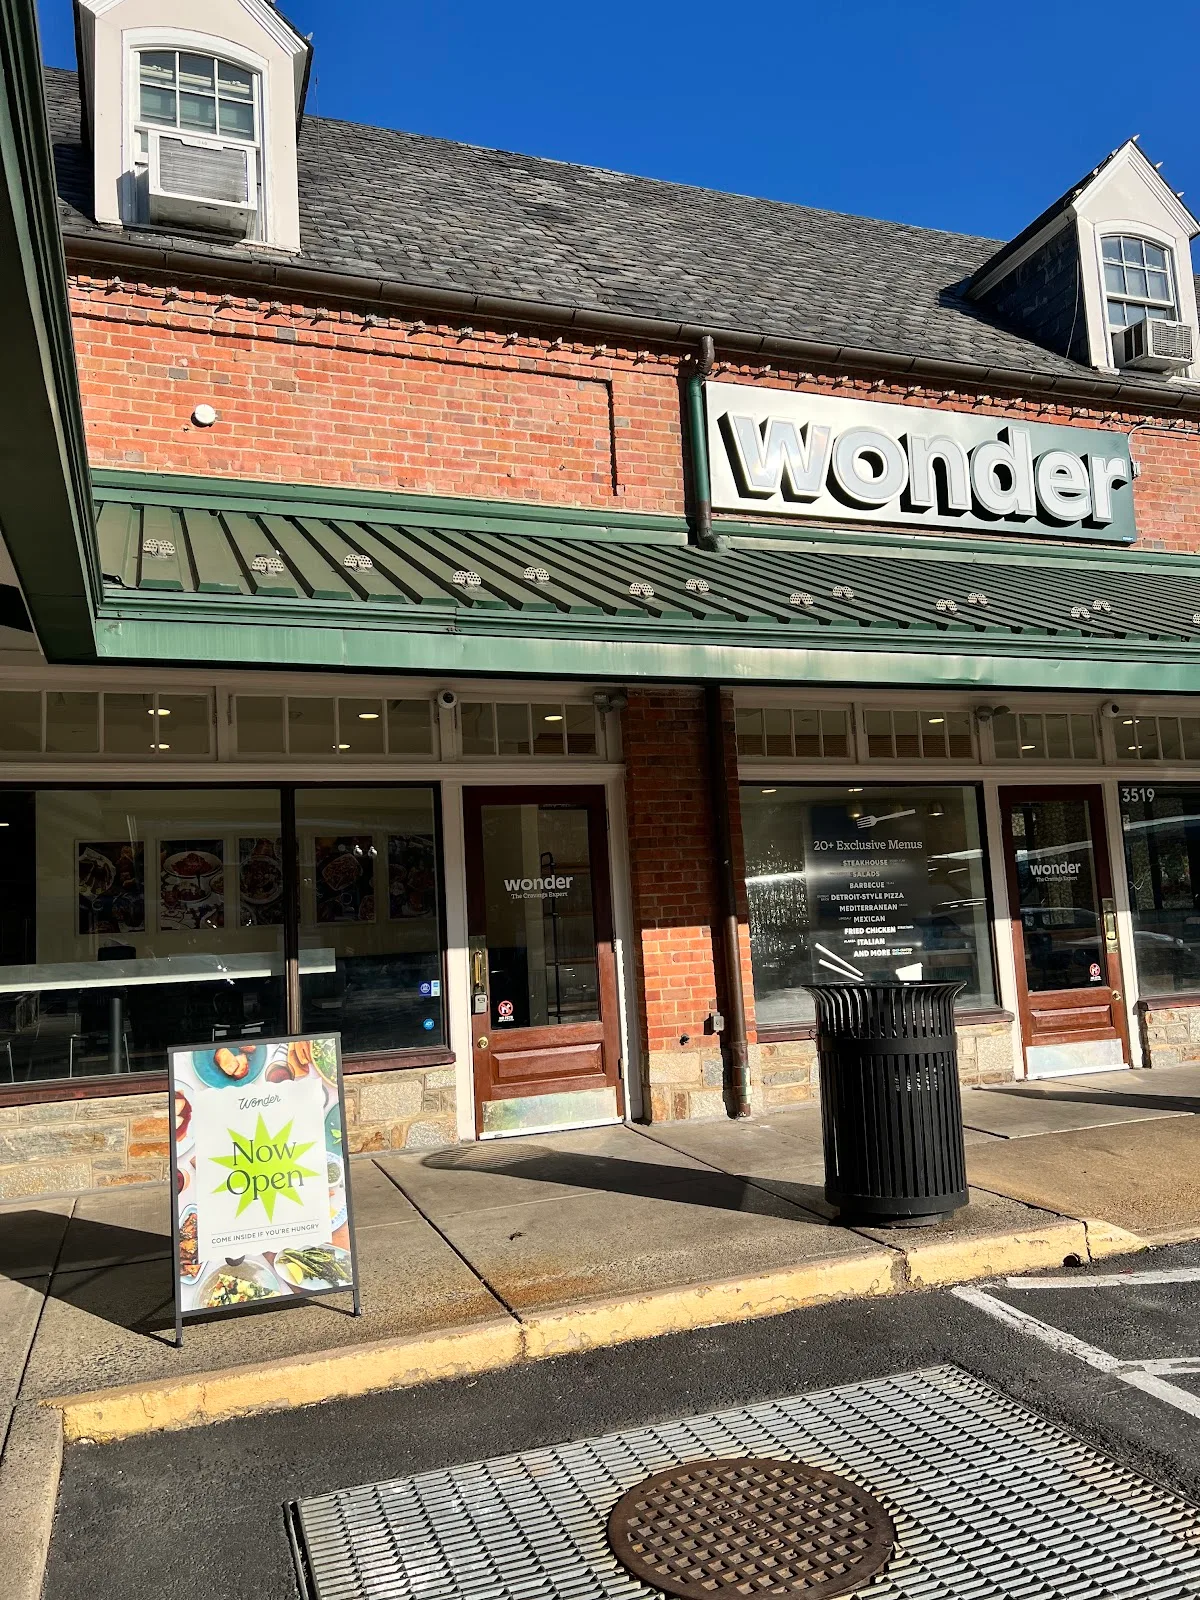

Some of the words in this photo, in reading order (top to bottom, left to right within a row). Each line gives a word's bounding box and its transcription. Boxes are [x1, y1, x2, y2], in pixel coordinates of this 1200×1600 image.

[720, 411, 1129, 527] wonder
[1121, 788, 1155, 802] 3519
[814, 840, 834, 850] 20+
[836, 840, 886, 850] Exclusive
[888, 839, 923, 850] Menus
[843, 859, 888, 867] STEAKHOUSE
[1030, 861, 1081, 875] wonder
[504, 874, 573, 891] wonder
[849, 881, 885, 889] BARBECUE
[830, 893, 883, 901] DETROIT-STYLE
[839, 904, 898, 912] MEDITERRANEAN
[853, 915, 886, 923] MEXICAN
[844, 927, 865, 935] FRIED
[865, 926, 896, 934] CHICKEN
[857, 938, 885, 946] ITALIAN
[870, 949, 891, 957] MORE
[238, 1094, 282, 1110] Wonder
[232, 1139, 297, 1166] Now
[226, 1169, 304, 1201] Open
[211, 1236, 232, 1244] COME
[233, 1232, 256, 1241] INSIDE
[265, 1227, 290, 1236] YOU'RE
[291, 1223, 319, 1232] HUNGRY
